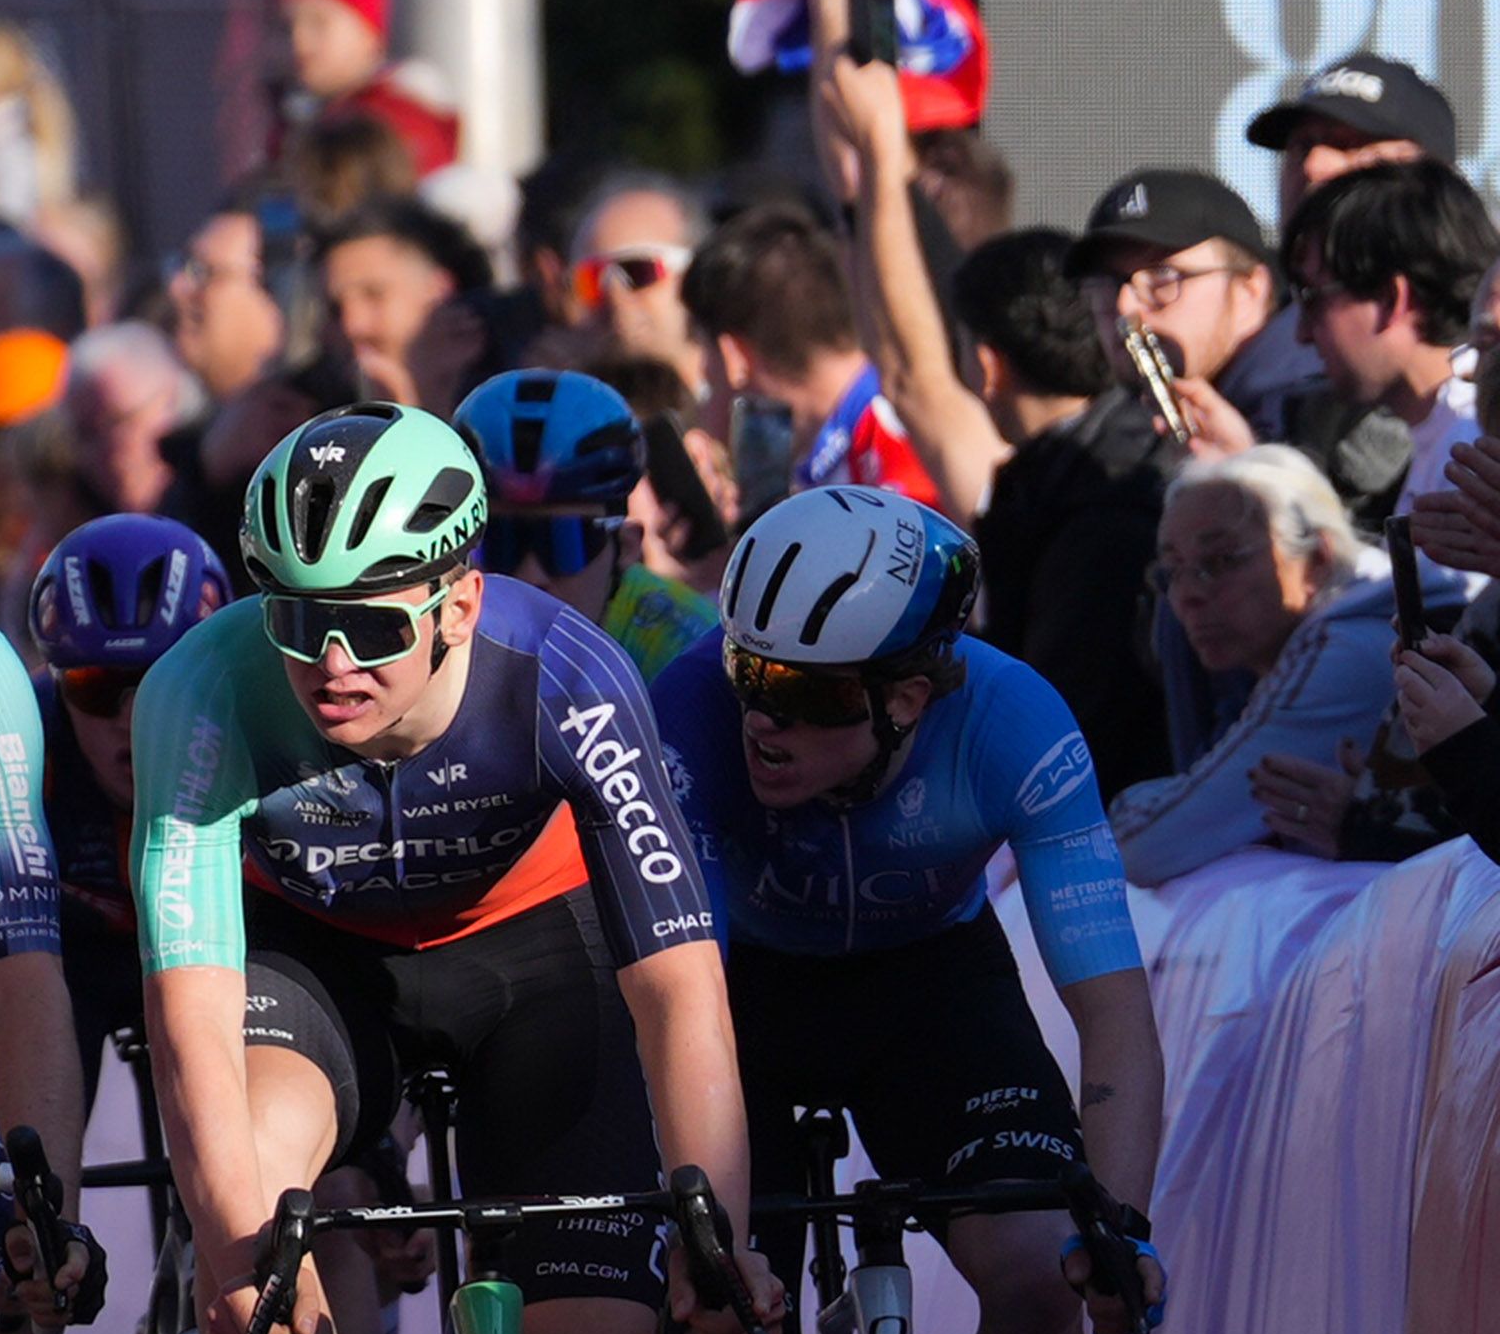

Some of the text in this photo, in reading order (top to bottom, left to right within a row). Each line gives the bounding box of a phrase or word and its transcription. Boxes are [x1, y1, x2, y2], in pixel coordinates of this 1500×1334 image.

[885, 517, 916, 585] NICE
[64, 556, 91, 627] LAZER
[160, 549, 188, 625] LAZER
[402, 793, 514, 818] VAN RYSEL
[560, 703, 682, 884] Adecco
[965, 1087, 1039, 1113] DIFFU
[993, 1131, 1076, 1161] SWISS
[536, 1262, 629, 1283] CMA CGM
